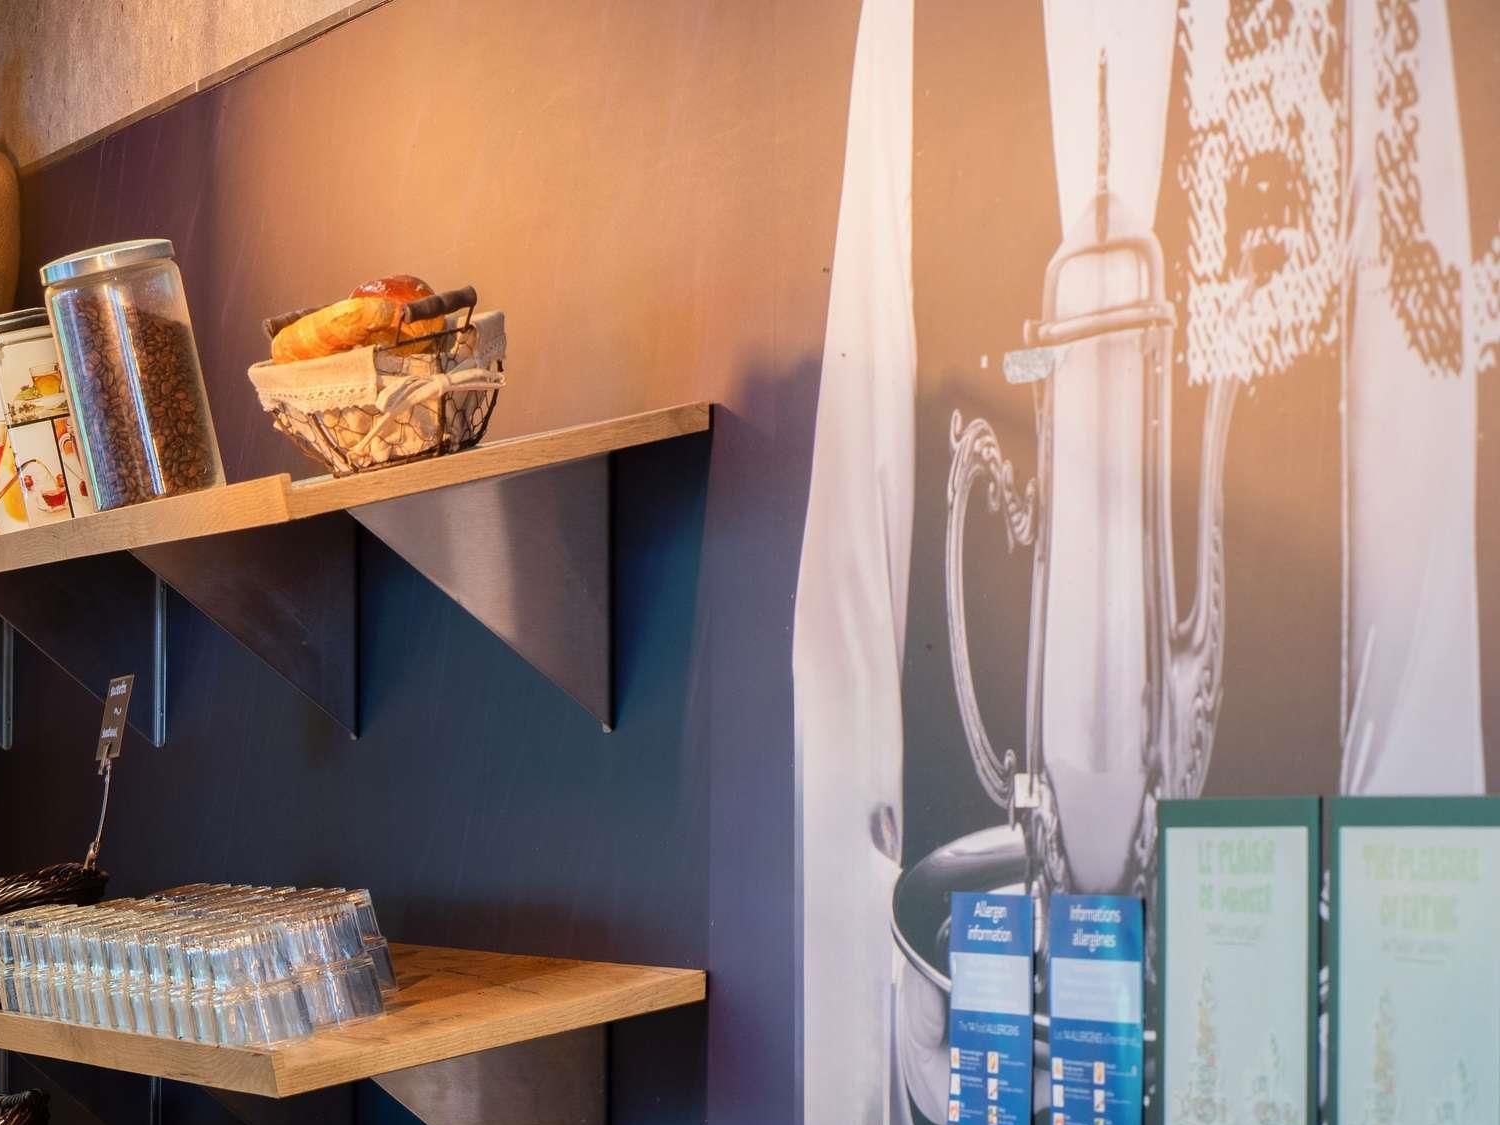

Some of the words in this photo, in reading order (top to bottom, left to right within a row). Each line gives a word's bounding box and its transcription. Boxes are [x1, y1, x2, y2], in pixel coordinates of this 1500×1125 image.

[973, 900, 1008, 924] Allergen
[1069, 904, 1122, 923] Informations
[967, 924, 1013, 942] information
